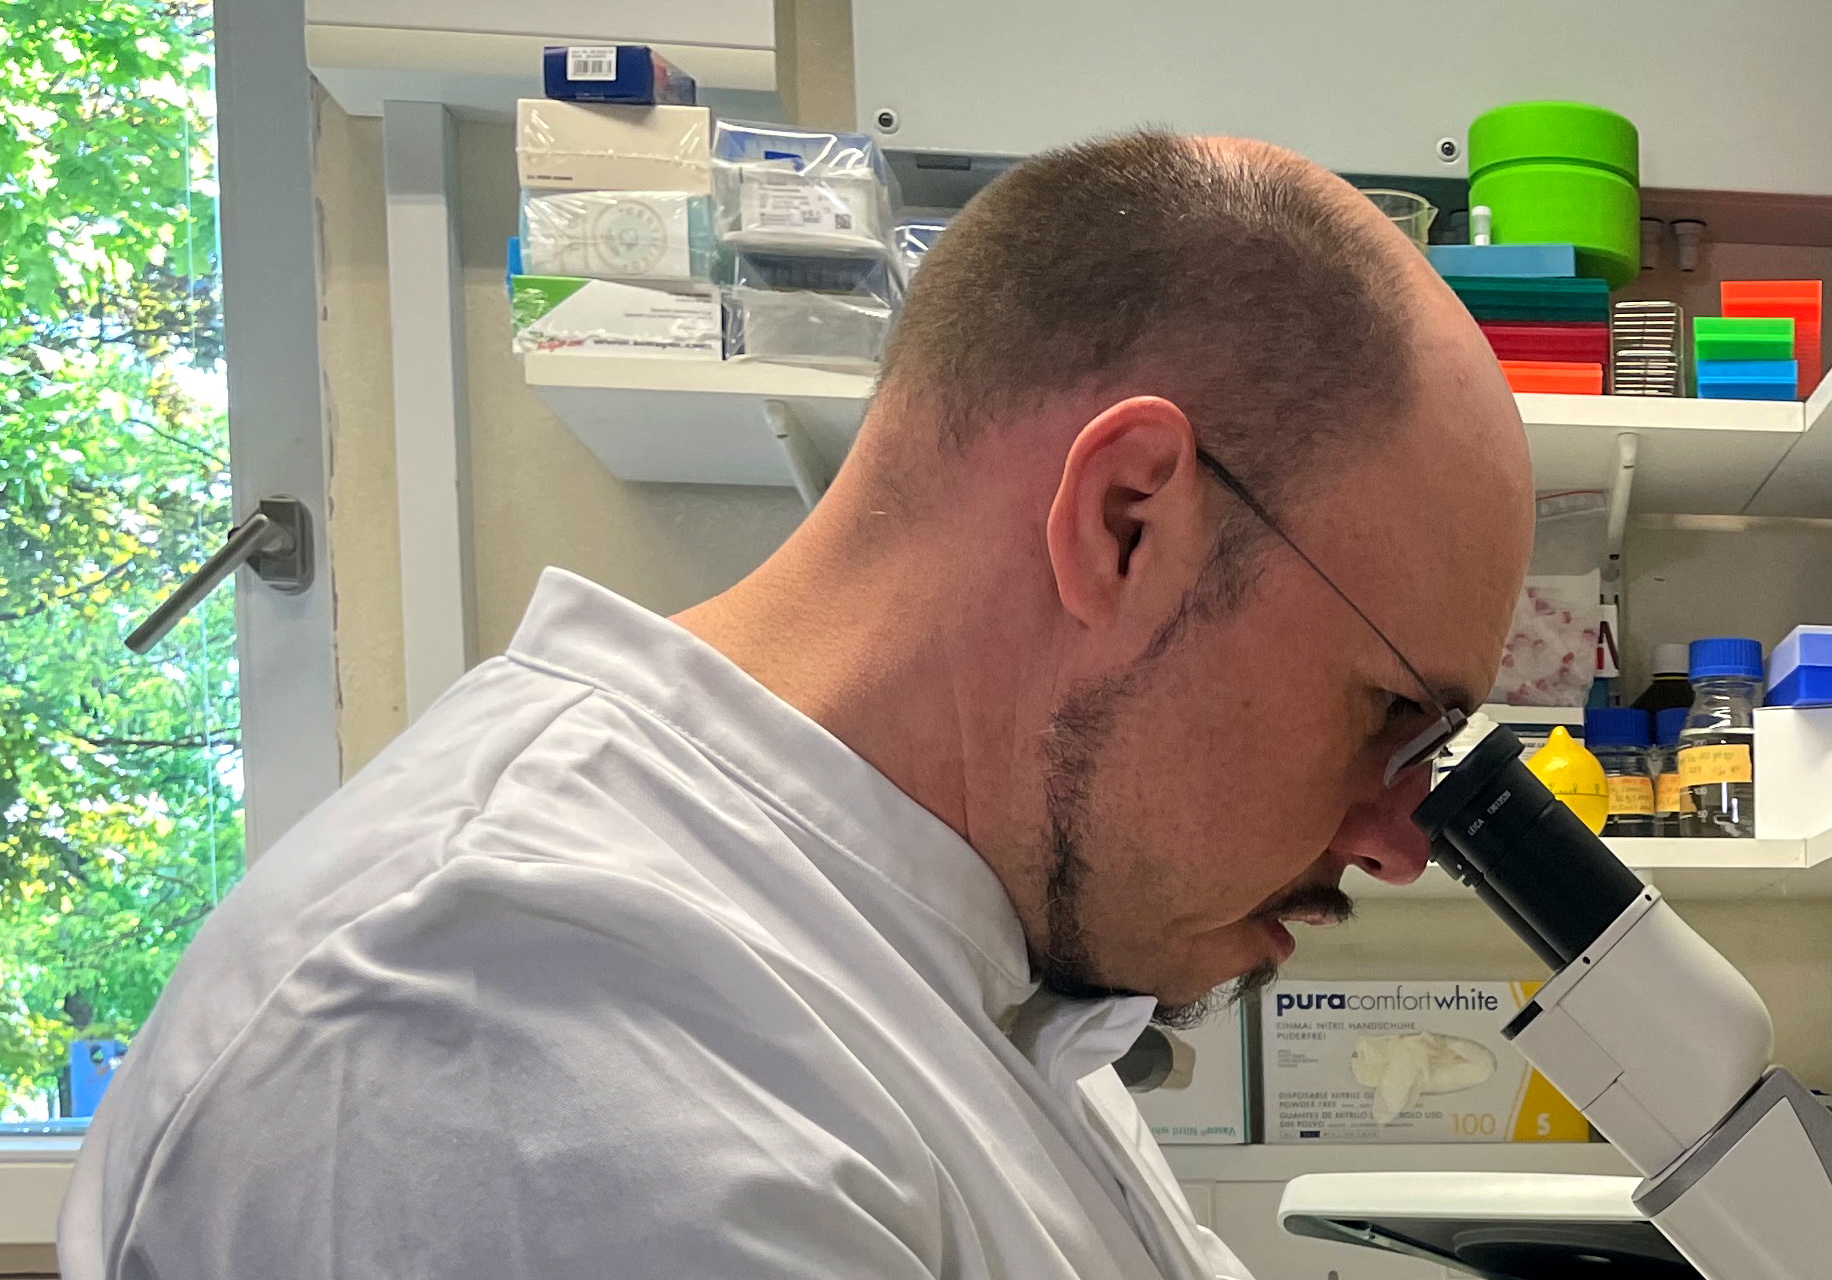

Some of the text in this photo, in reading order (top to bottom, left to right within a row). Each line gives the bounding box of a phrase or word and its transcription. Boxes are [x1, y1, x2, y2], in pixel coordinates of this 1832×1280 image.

[1349, 1022, 1416, 1030] HANDSCHUHE
[1452, 1113, 1496, 1136] 100
[1536, 1112, 1552, 1137] S
